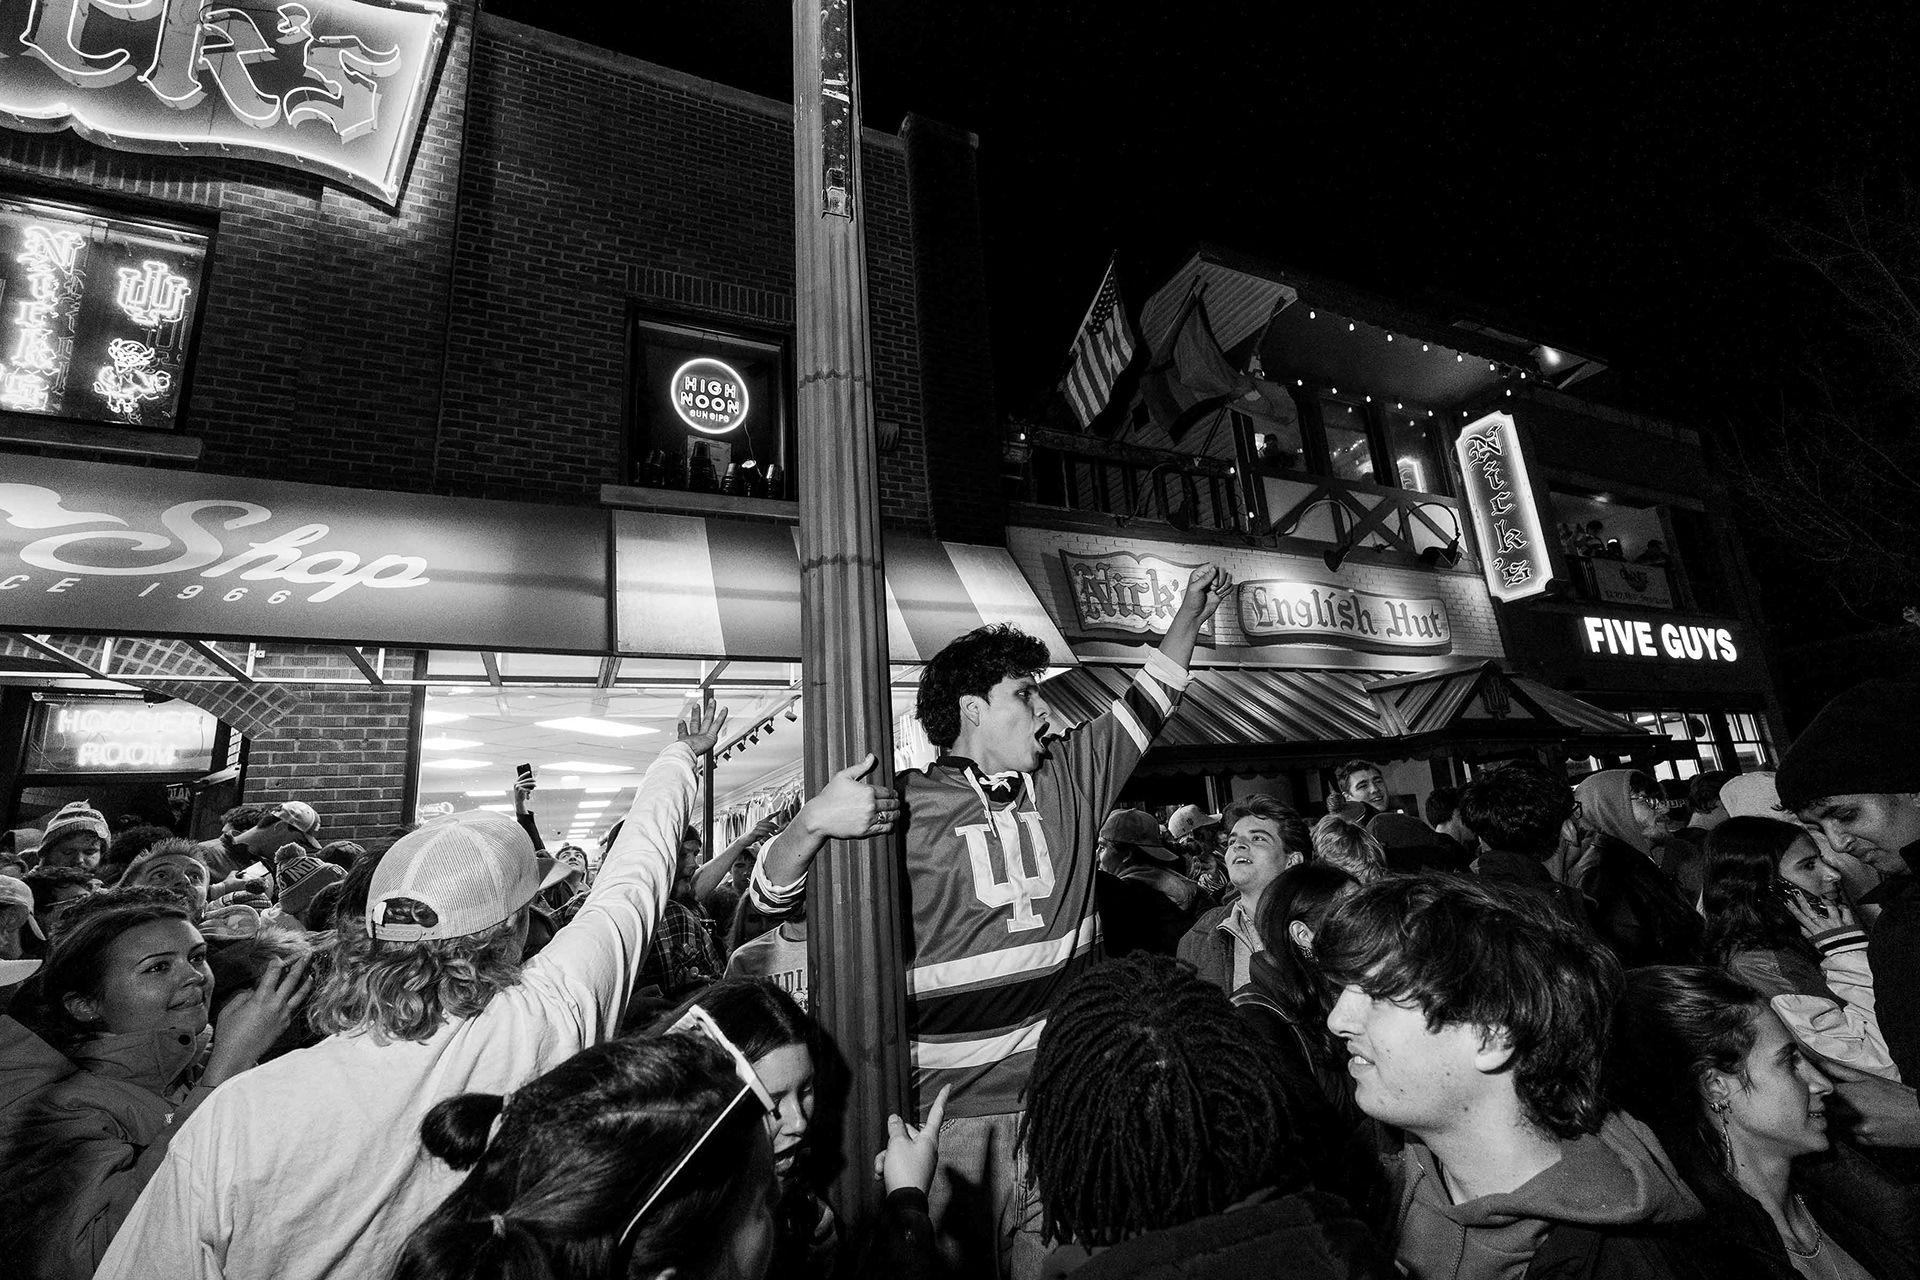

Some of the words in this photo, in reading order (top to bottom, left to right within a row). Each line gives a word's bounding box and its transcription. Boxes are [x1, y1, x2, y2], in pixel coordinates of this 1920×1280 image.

[684, 376, 736, 398] HIGH
[680, 391, 739, 414] NOON
[20, 499, 430, 602] Shop
[138, 582, 291, 604] 1966
[1073, 562, 1186, 620] Nick'
[1248, 586, 1378, 636] English
[1384, 600, 1443, 638] Hut
[1583, 616, 1658, 657] FIVE
[1661, 623, 1738, 662] GUYS
[57, 709, 199, 733] HOOSIER
[77, 742, 177, 766] ROOM
